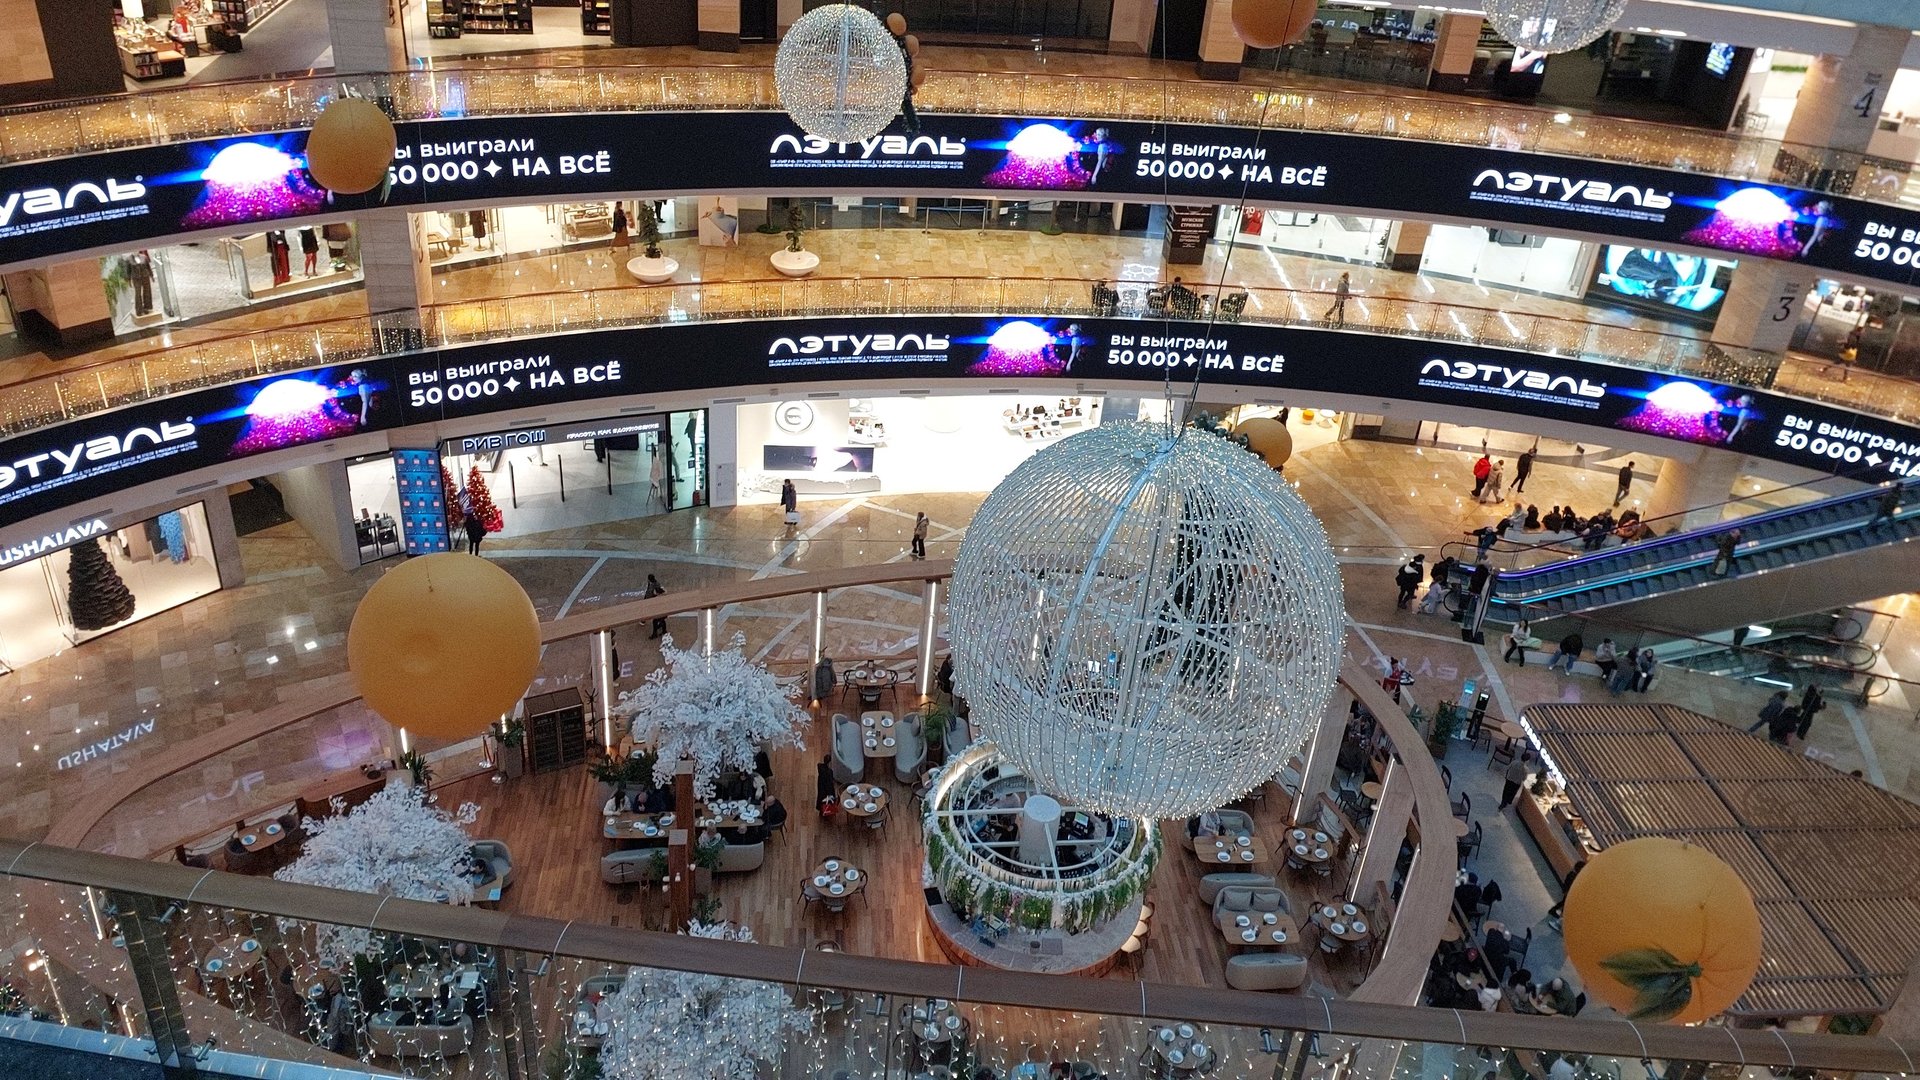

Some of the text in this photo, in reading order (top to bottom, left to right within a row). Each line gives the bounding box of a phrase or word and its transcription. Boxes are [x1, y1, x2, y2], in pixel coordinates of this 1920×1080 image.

[1853, 87, 1876, 118] 4
[394, 138, 535, 160] ы выиграли
[1171, 143, 1267, 161] выиграли
[512, 157, 551, 177] НА
[559, 150, 611, 176] ВСЁ
[1240, 164, 1273, 183] НА
[1280, 165, 1328, 187] ВСЁ
[1772, 296, 1795, 322] 3
[1110, 334, 1228, 352] вы выиграли
[408, 354, 551, 387] вы выиграли
[1205, 353, 1235, 371] НА
[1241, 354, 1285, 373] ВСЁ
[525, 371, 566, 391] НА
[573, 360, 622, 385] ВСЁ
[462, 429, 546, 453] РИВ ГОШ
[566, 430, 597, 440] КРАСОТА
[597, 428, 612, 436] КАК
